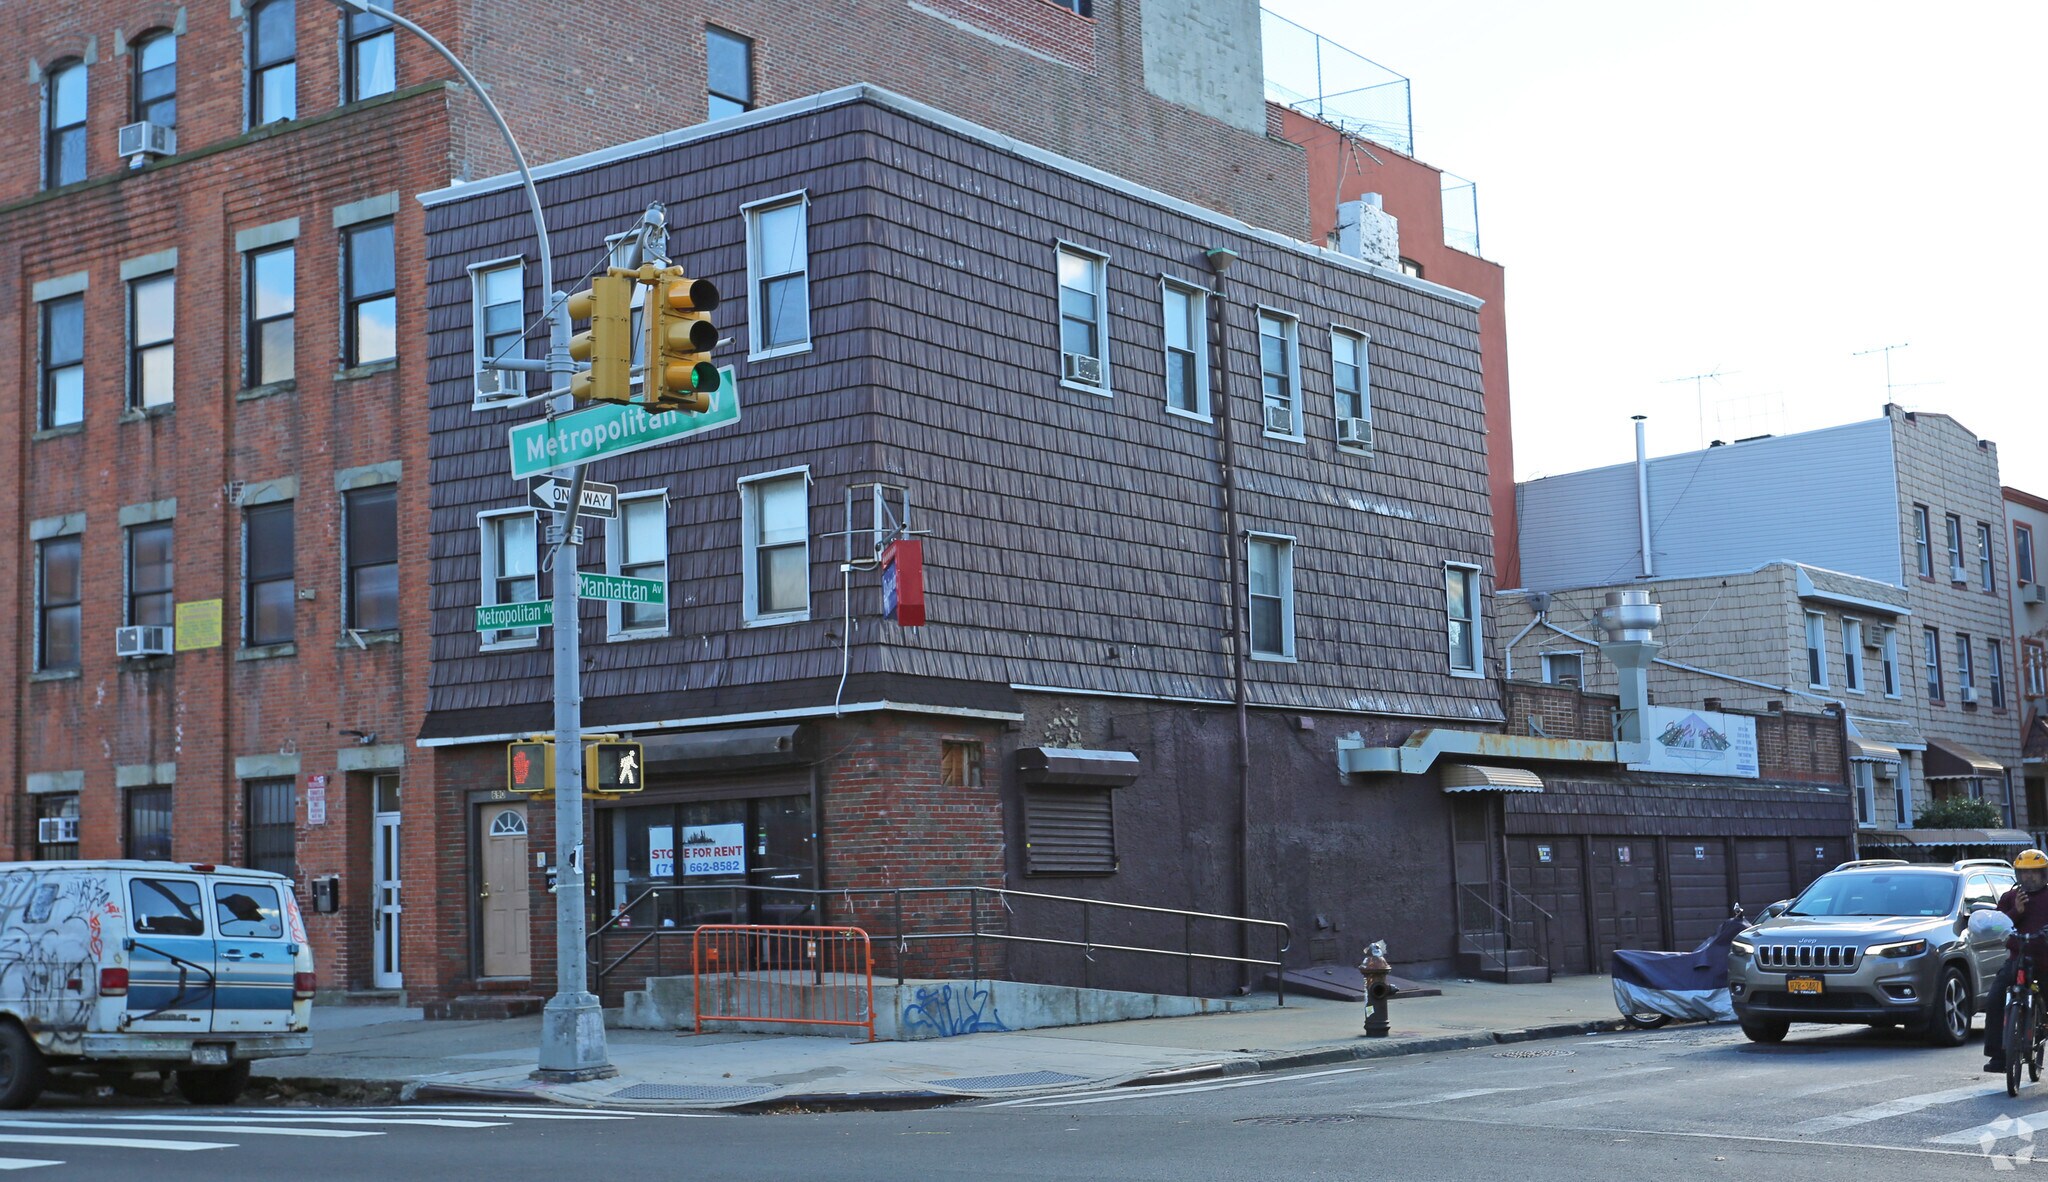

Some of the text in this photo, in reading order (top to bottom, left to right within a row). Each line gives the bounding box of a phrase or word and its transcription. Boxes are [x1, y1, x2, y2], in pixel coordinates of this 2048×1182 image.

[526, 409, 677, 463] Metropolitan
[553, 487, 608, 507] ON WAY
[579, 576, 662, 601] Manhattan Av
[477, 606, 541, 627] Metropolitan
[651, 845, 743, 859] STOE FOR RENT
[655, 860, 740, 875] (71) 662-8582
